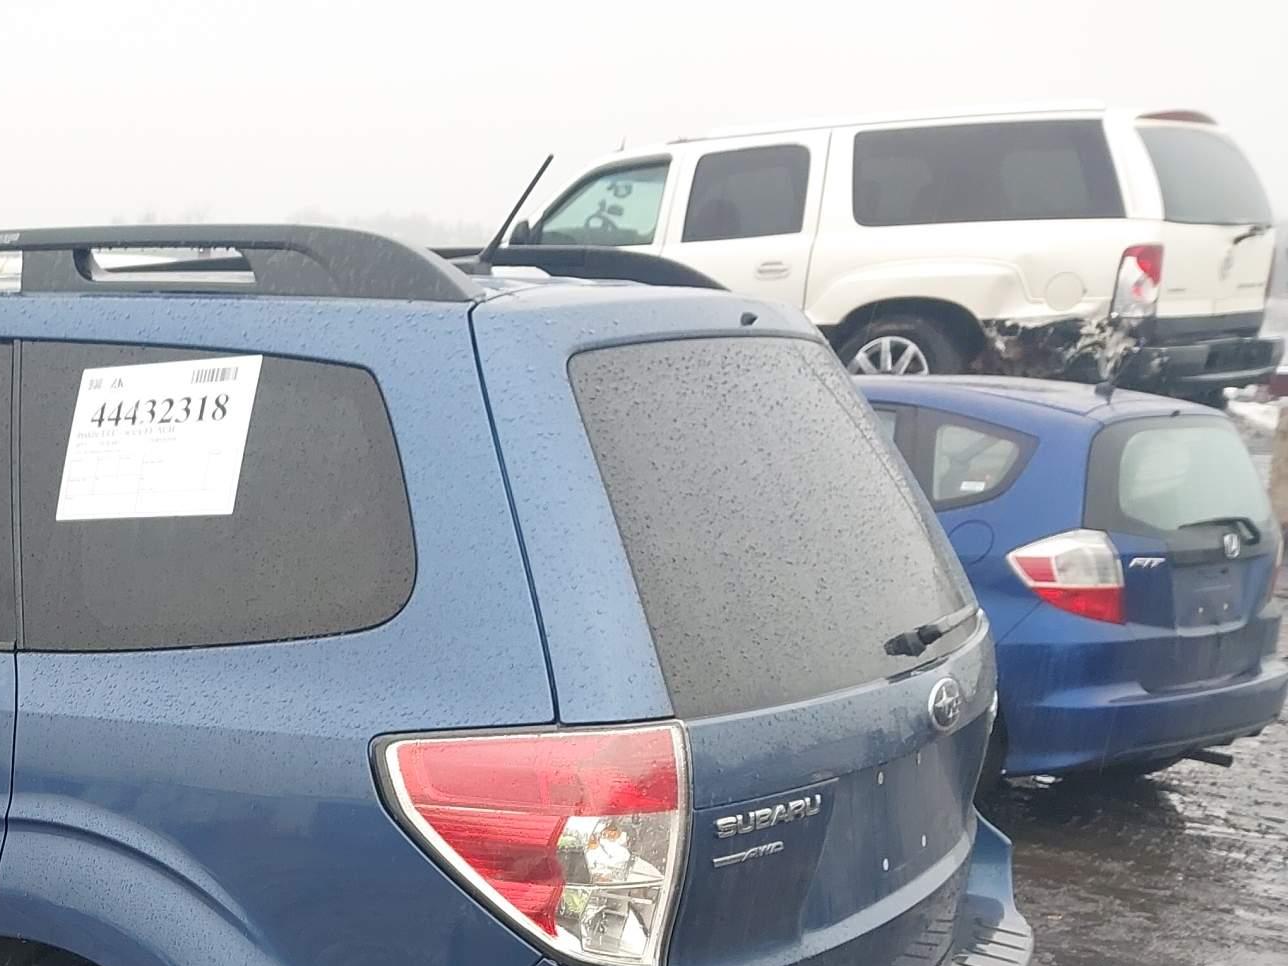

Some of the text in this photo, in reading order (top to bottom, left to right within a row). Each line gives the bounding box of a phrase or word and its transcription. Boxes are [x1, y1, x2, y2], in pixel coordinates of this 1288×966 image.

[90, 393, 230, 428] 44432318
[1128, 557, 1167, 569] FIT
[715, 793, 822, 839] SUBARU
